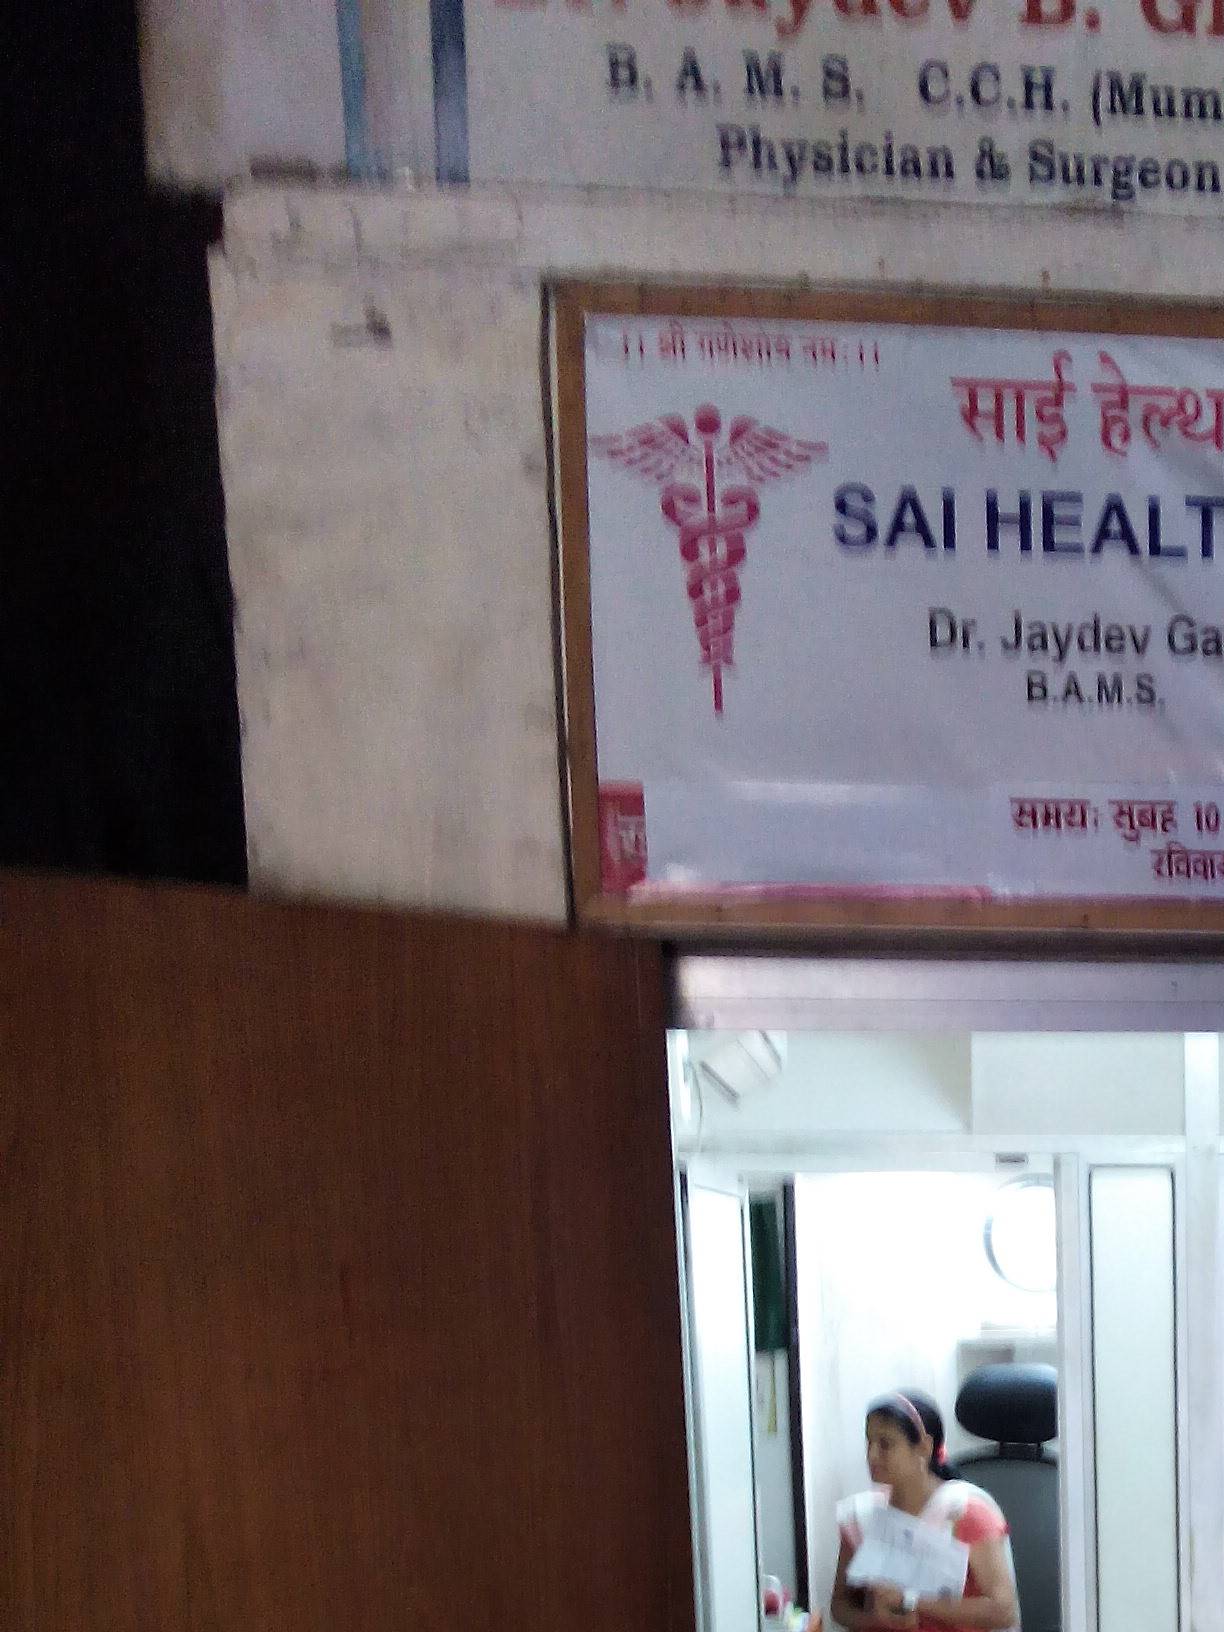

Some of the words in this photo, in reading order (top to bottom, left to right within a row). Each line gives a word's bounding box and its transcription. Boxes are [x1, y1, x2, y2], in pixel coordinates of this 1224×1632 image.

[715, 123, 956, 194] Physician
[974, 135, 1011, 186] &
[1028, 137, 1222, 203] Surgeon
[950, 349, 1076, 464] साई
[834, 481, 957, 554] SAI
[928, 607, 986, 653] Dr.
[1000, 608, 1150, 664] Jaydev
[1108, 798, 1178, 844] सुबह
